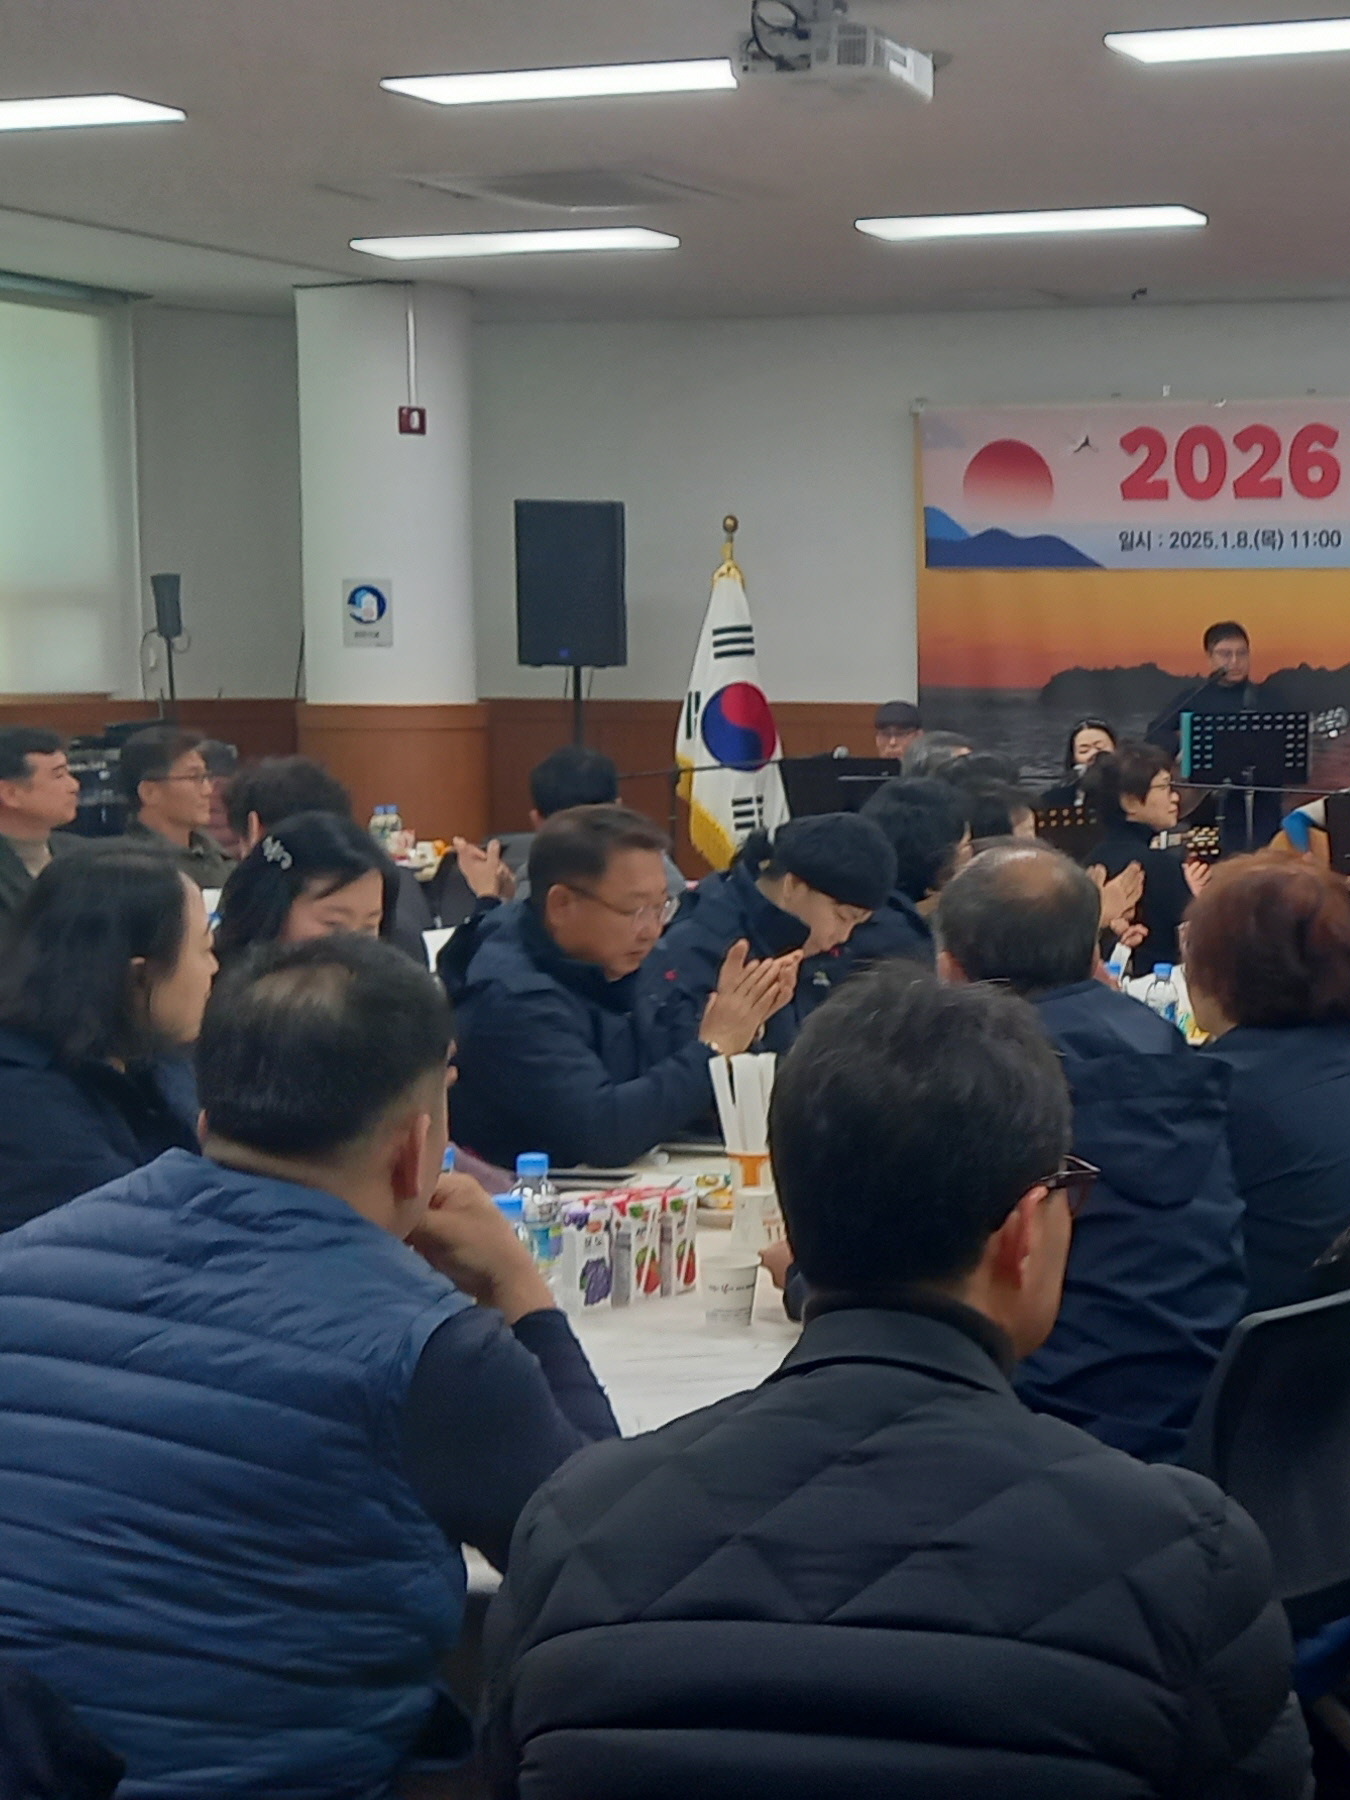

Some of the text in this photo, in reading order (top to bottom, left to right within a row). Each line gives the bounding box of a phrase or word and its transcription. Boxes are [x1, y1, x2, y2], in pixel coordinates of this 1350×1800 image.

[1119, 422, 1341, 501] 2026
[1118, 530, 1151, 551] 일시
[1290, 529, 1342, 549] 11:00
